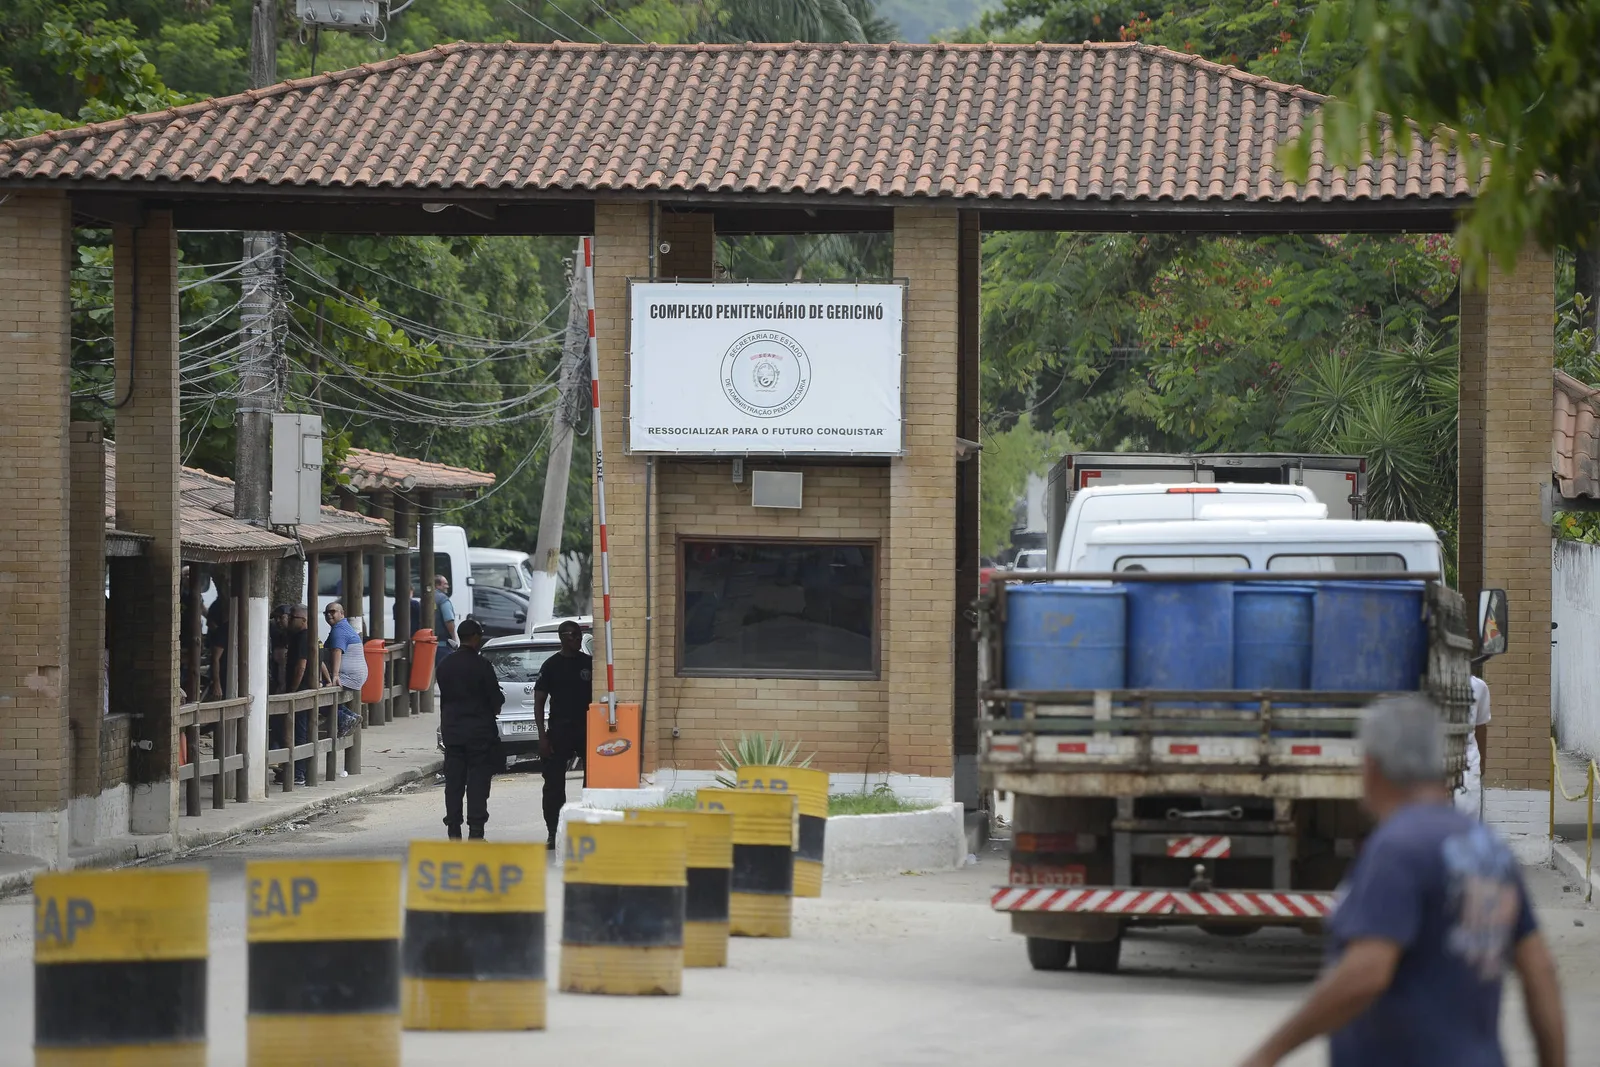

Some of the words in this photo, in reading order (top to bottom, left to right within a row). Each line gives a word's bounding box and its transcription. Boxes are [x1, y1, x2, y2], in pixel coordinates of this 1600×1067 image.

[650, 304, 713, 319] COMPLEXO
[716, 302, 805, 319] PENITENCIÁRIO
[809, 305, 823, 319] DE
[827, 303, 883, 320] GERICINÓ
[729, 333, 768, 358] SECRETARIA
[769, 333, 779, 341] DE
[780, 337, 803, 358] ESTADO
[725, 378, 732, 387] DE
[728, 388, 773, 415] ADMINISTRAÇÃO
[732, 427, 759, 435] PARA
[761, 427, 769, 435] O
[772, 427, 814, 435] FUTURO
[417, 858, 523, 894] SEAP
